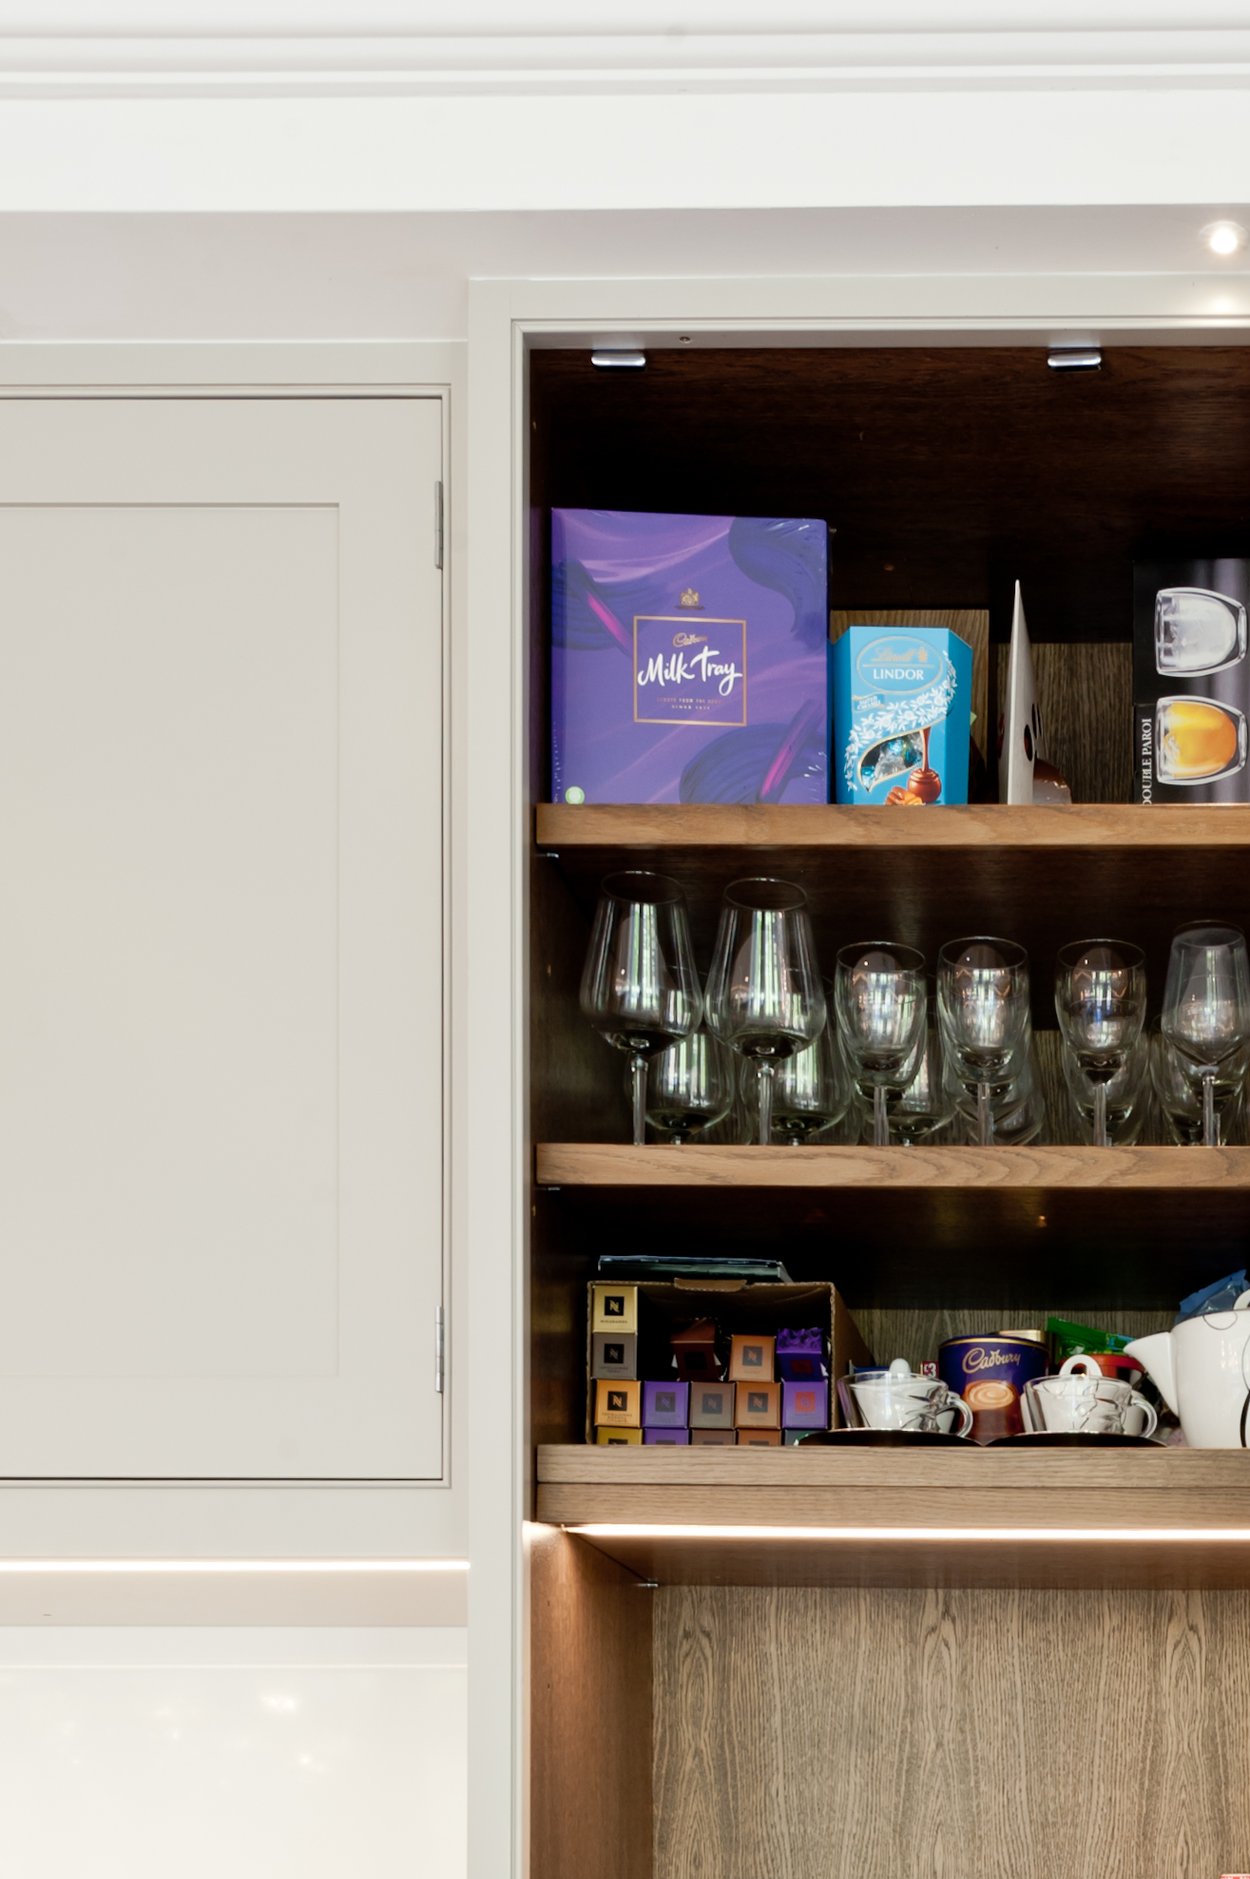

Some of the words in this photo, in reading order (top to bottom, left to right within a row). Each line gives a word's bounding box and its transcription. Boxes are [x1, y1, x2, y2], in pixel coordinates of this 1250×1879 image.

[637, 651, 696, 687] Milk
[689, 645, 744, 697] Tray
[872, 668, 925, 681] LINDOR
[1141, 718, 1153, 756] PAROI
[962, 1347, 1021, 1374] Cadbury
